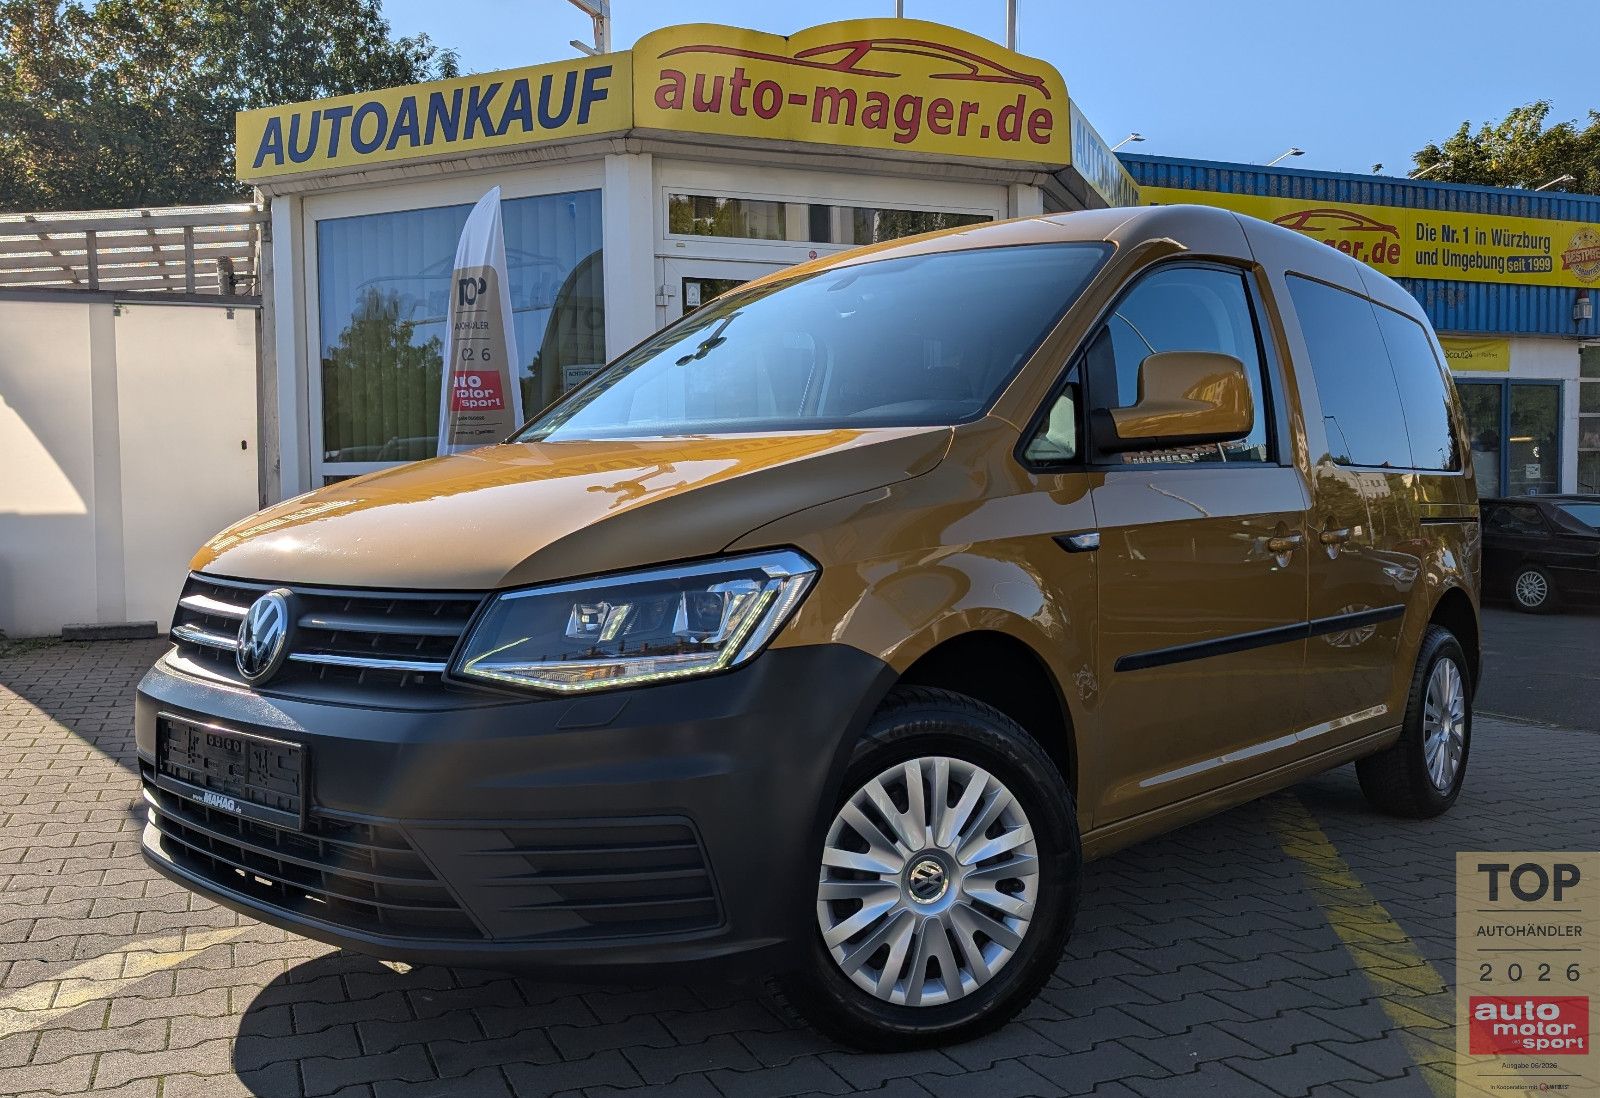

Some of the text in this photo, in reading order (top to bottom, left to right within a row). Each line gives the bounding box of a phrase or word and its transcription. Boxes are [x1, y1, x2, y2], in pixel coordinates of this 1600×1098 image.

[252, 65, 613, 168] AUTOANKAUF
[654, 67, 1053, 144] auto-mager.de
[1415, 222, 1551, 254] Die Nr. 1 in Würzburg
[1415, 248, 1551, 274] und Umgebung seit 1999
[461, 397, 501, 409] sport
